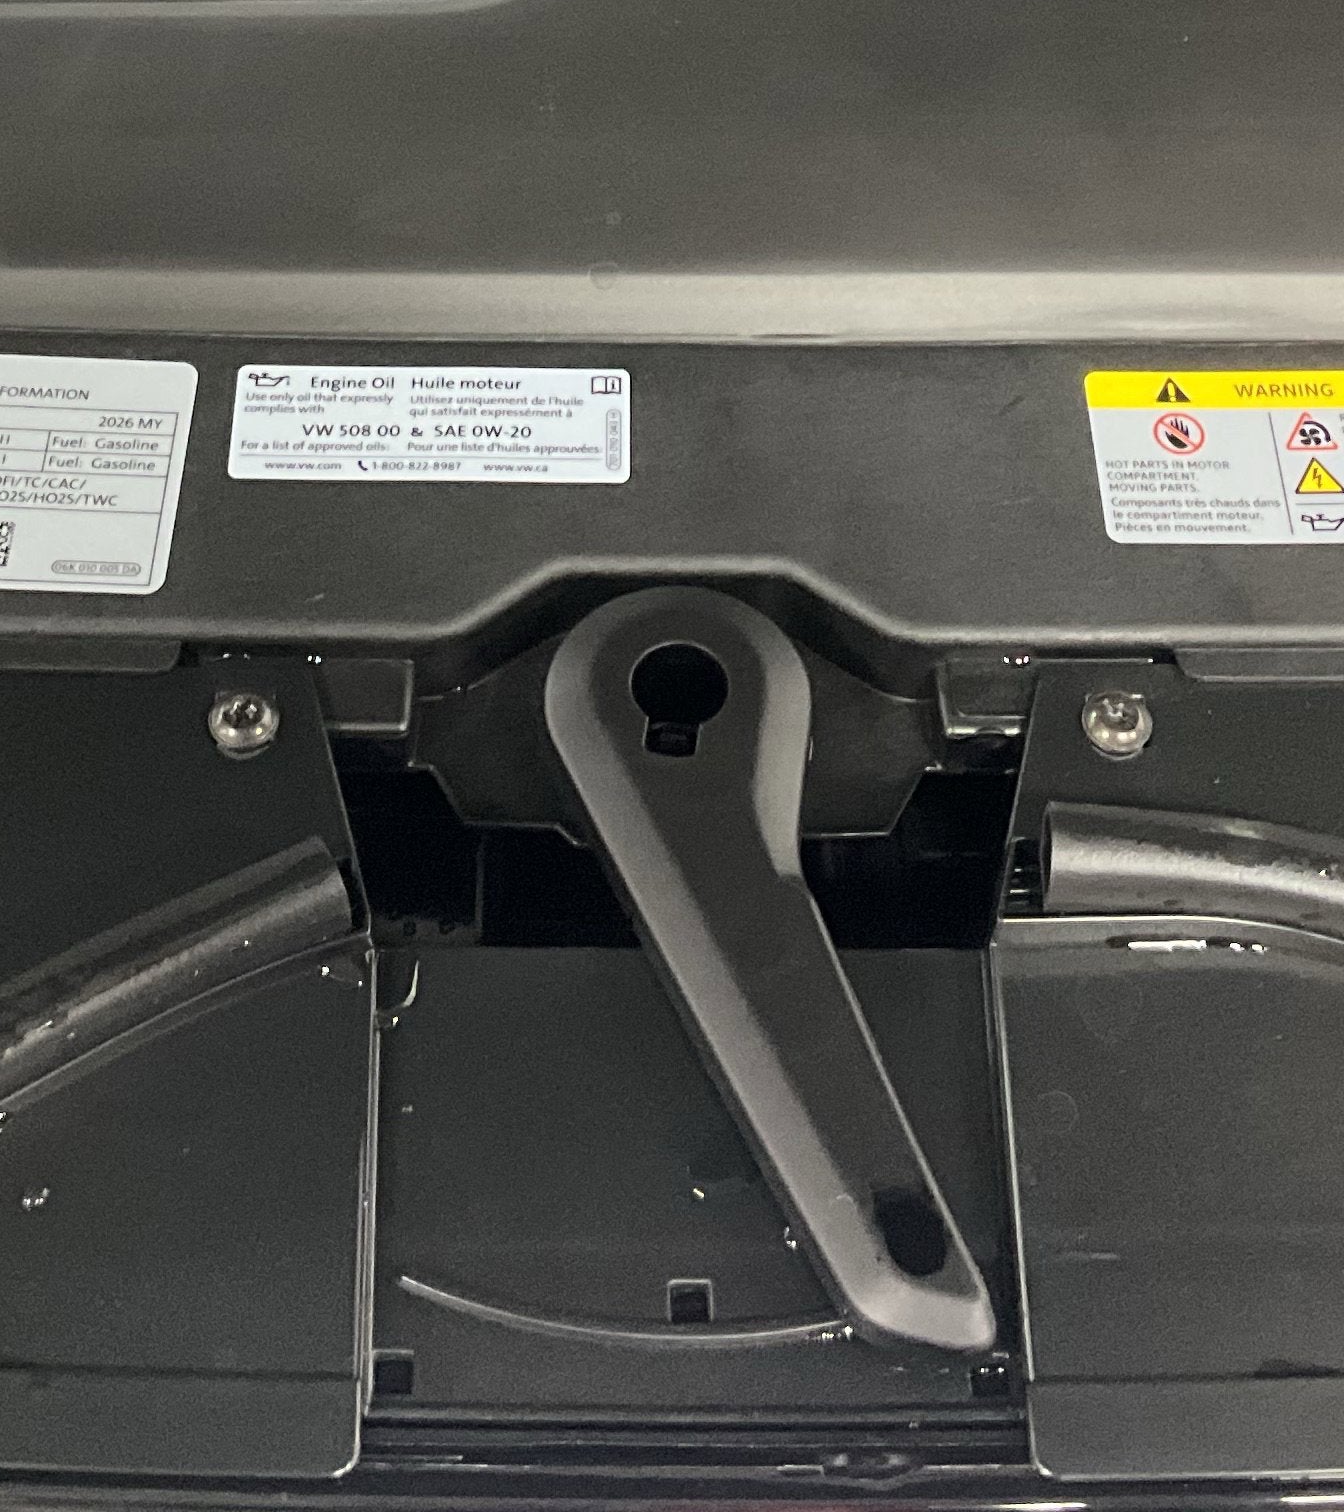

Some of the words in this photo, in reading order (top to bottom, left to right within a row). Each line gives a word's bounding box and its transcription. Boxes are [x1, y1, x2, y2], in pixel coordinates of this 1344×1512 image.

[310, 375, 367, 392] Engine
[371, 376, 395, 389] Oil
[412, 376, 455, 390] Huile
[459, 378, 522, 390] moteur
[1234, 383, 1334, 398] WARNING
[246, 392, 267, 402] Use
[269, 392, 294, 404] only
[296, 392, 311, 402] oil
[314, 392, 337, 403] that
[340, 393, 394, 406] expressly
[410, 395, 453, 405] Utilisez
[456, 395, 529, 407] uniquement
[531, 396, 546, 406] de
[244, 404, 296, 415] complies
[298, 403, 325, 413] with
[409, 407, 428, 418] qui
[431, 406, 477, 417] satisfait
[98, 415, 134, 429] 2026
[137, 418, 163, 431] MY
[302, 424, 335, 437] VW
[339, 424, 371, 437] 508
[377, 424, 401, 437] 00
[411, 427, 423, 437] &
[434, 425, 467, 438] SAE
[472, 425, 532, 438] 0W-20
[51, 436, 87, 448] Fuel:
[94, 438, 159, 451] Gasoline
[240, 440, 260, 450] For
[262, 442, 269, 450] a
[272, 440, 289, 450] list
[292, 440, 305, 451] of
[307, 440, 363, 453] approved
[407, 441, 434, 452] Pour
[436, 443, 458, 452] une
[460, 442, 485, 452] liste
[48, 455, 83, 468] Fuel:
[91, 457, 156, 471] Gasoline
[1106, 460, 1129, 469] HOT
[1132, 460, 1169, 469] PARTS
[1172, 460, 1184, 469] IN
[1187, 460, 1231, 470] MOTOR
[1109, 483, 1157, 493] MOVING
[1111, 497, 1183, 509] Composants
[1209, 497, 1250, 508] chauds
[1253, 497, 1281, 508] dans
[1113, 509, 1124, 520] le
[1127, 510, 1213, 522] compartiment
[1156, 523, 1171, 532] en
